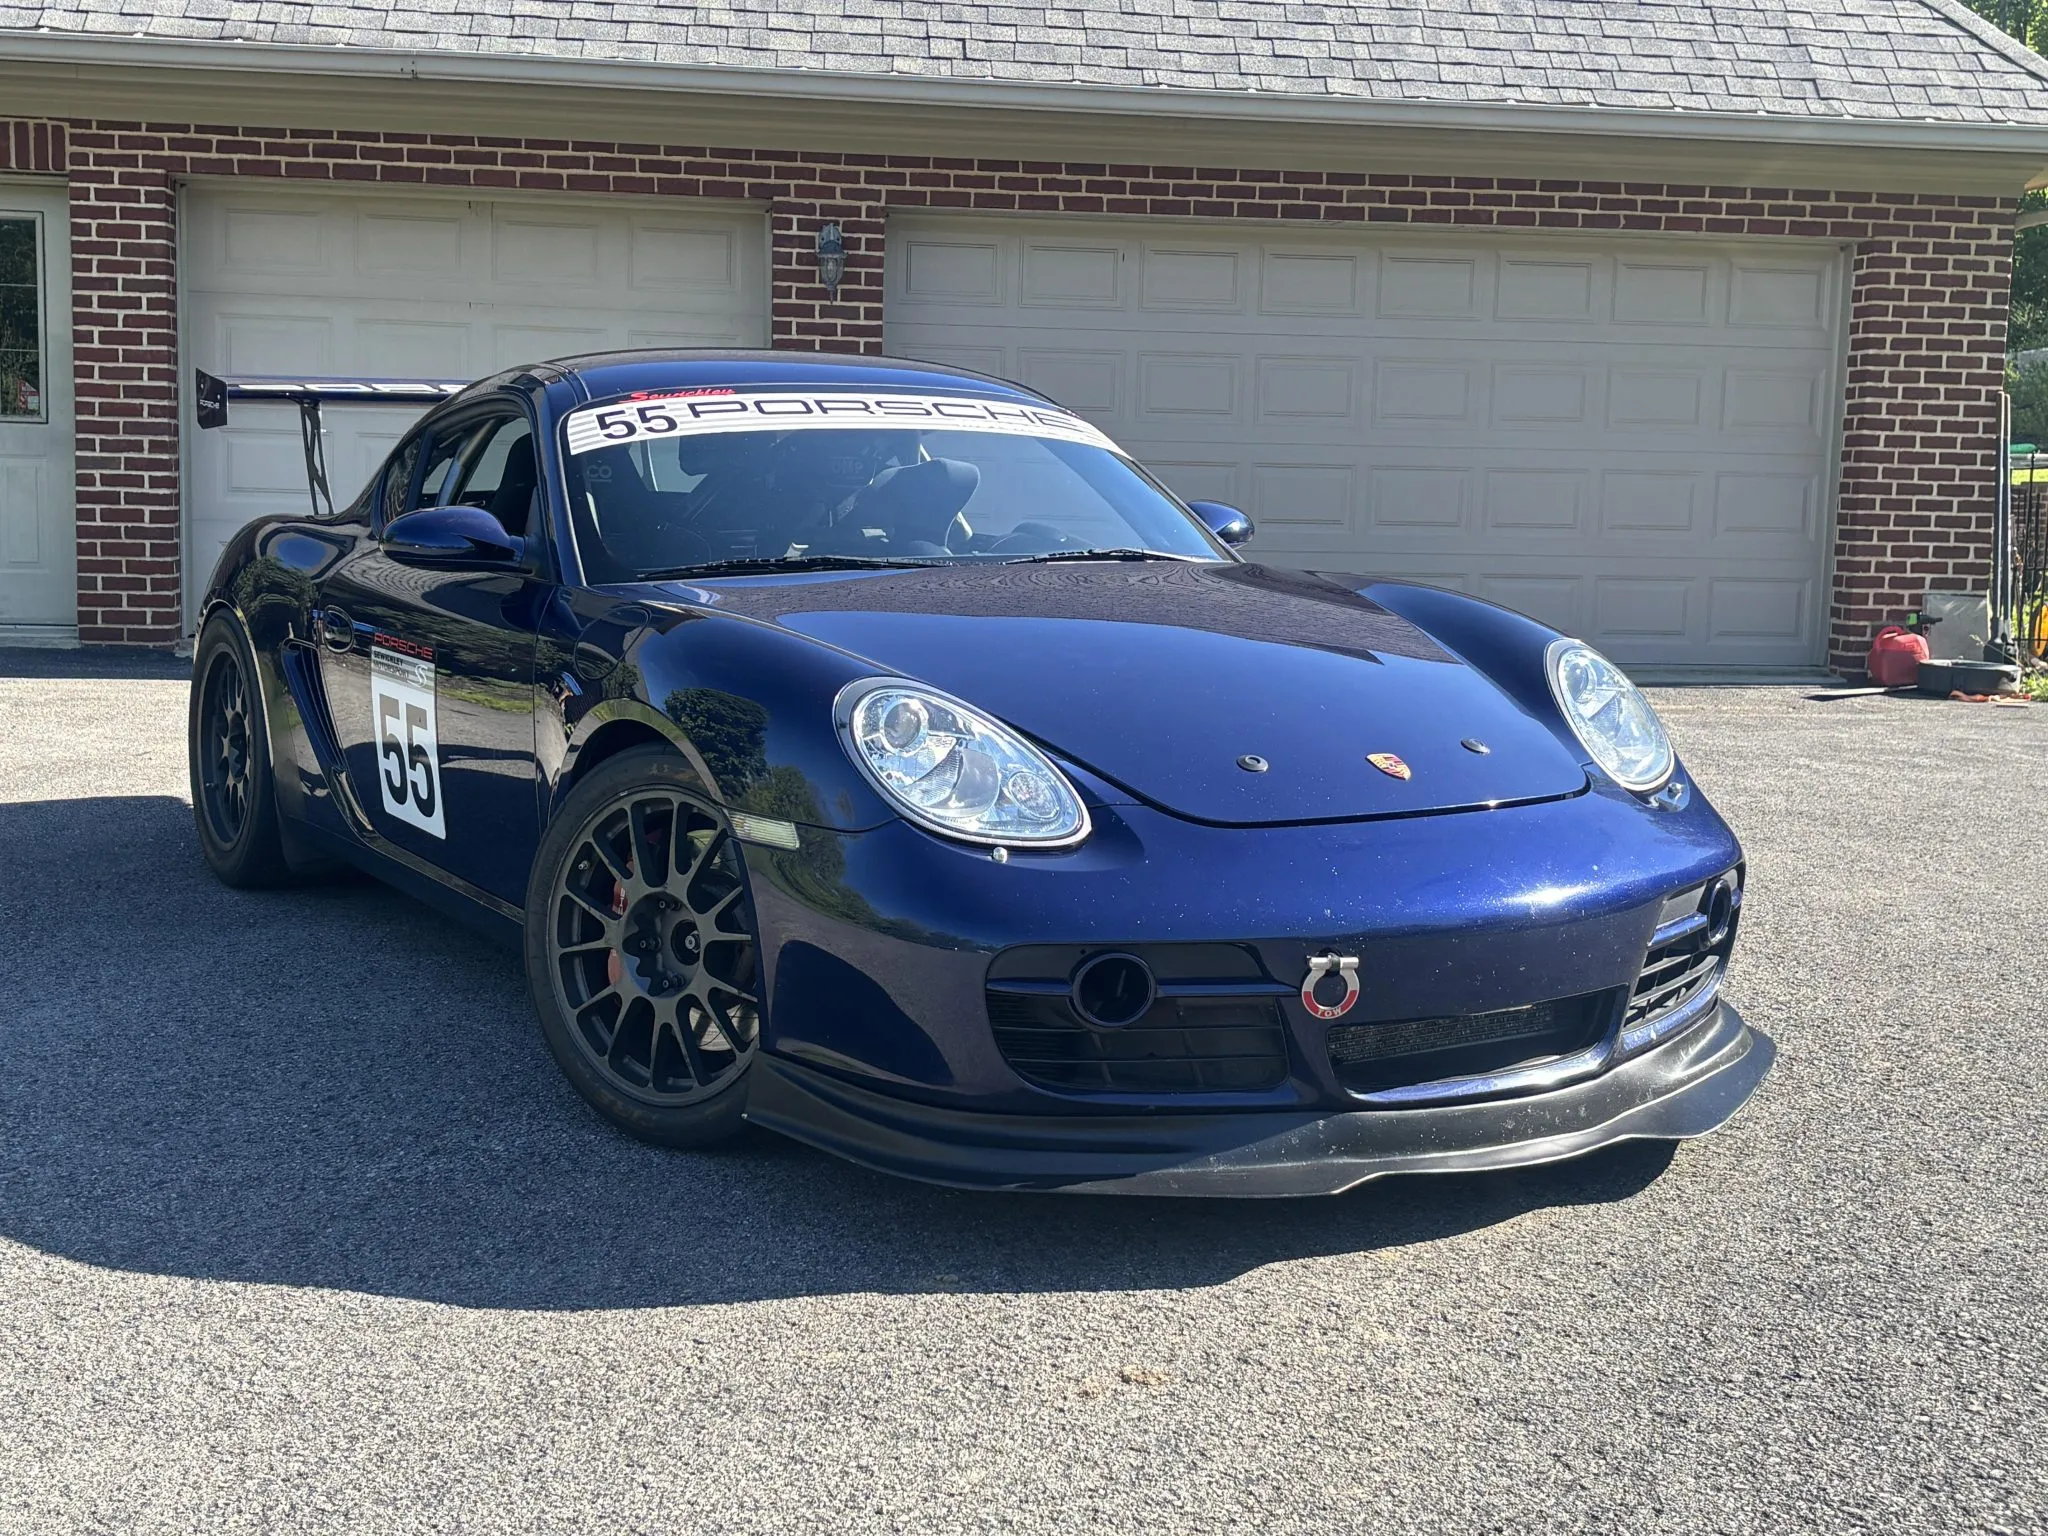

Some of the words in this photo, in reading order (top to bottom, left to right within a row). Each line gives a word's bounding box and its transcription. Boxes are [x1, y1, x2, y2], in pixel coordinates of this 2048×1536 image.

[596, 405, 678, 439] 55
[687, 400, 1084, 432] PORSCHE
[375, 632, 433, 659] PORSCHE
[379, 693, 436, 818] 55
[1318, 1006, 1341, 1017] TOW
